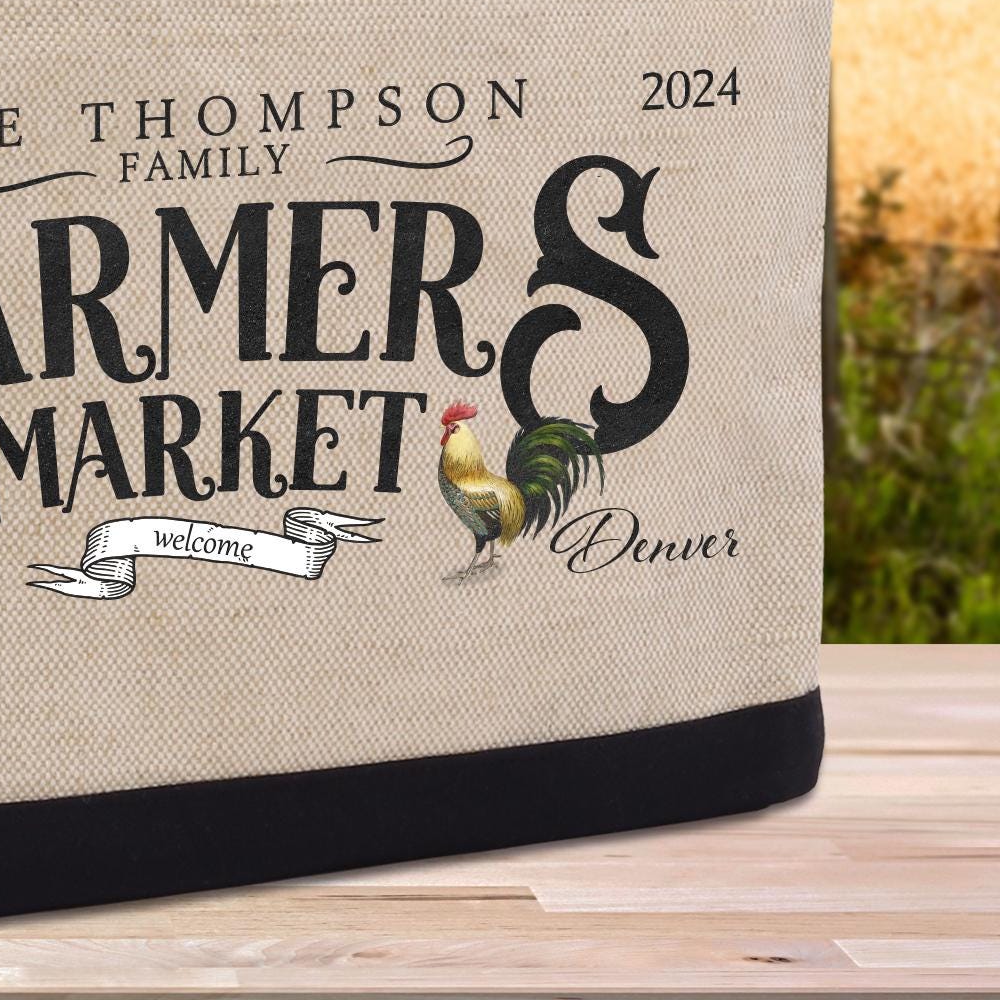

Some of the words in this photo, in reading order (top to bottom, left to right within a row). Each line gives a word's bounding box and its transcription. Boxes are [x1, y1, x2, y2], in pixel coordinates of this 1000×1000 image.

[81, 79, 527, 143] THOMPSON
[641, 66, 741, 111] 2024
[119, 143, 290, 183] FAMILY
[153, 523, 253, 559] welcome
[549, 507, 740, 574] Denver
